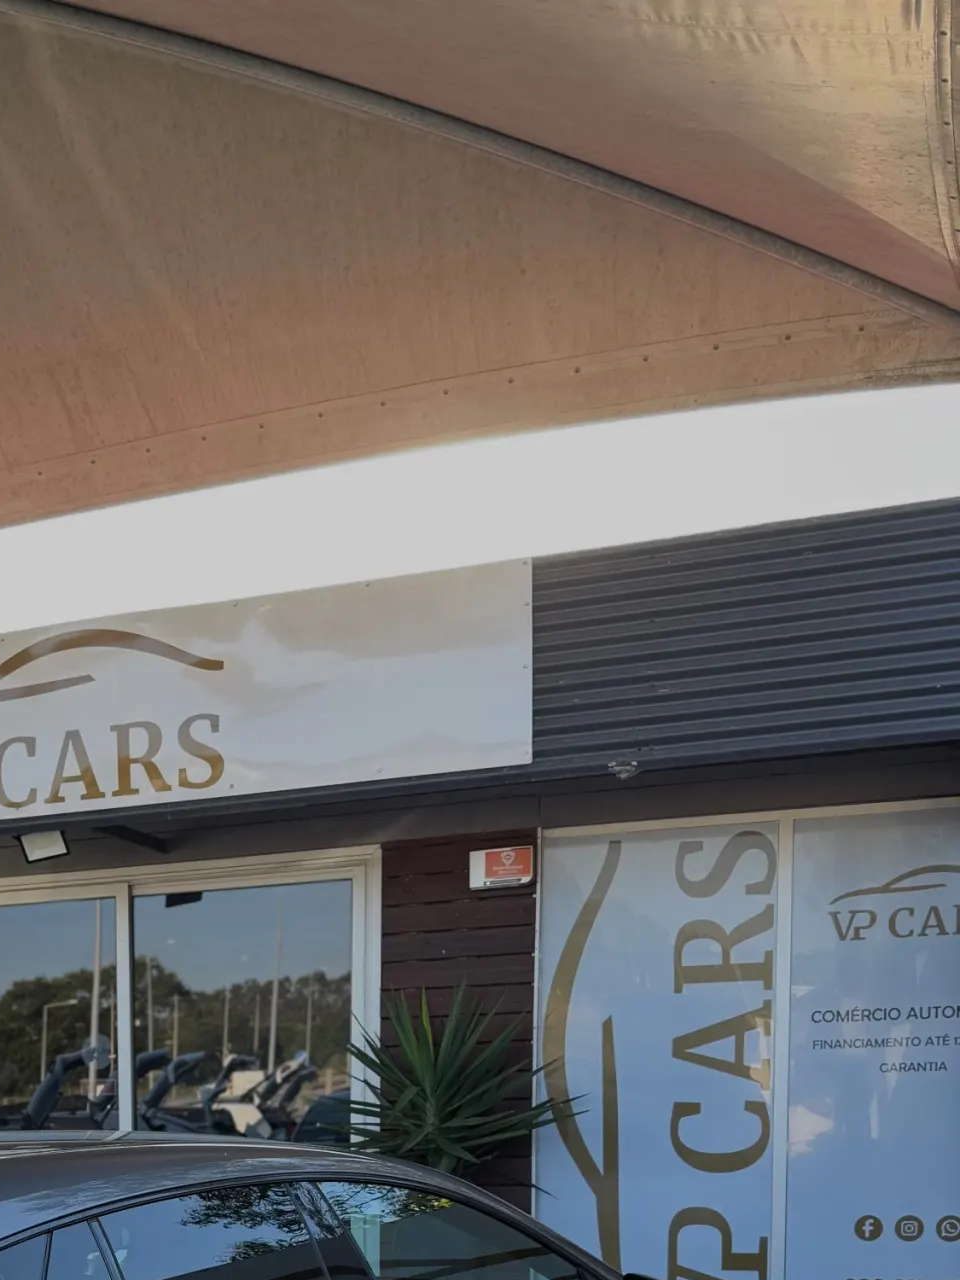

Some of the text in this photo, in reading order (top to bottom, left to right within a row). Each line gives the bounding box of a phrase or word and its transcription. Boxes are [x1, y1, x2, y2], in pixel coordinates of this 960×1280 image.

[827, 909, 877, 942] VP
[670, 830, 777, 1173] CARS
[811, 1005, 960, 1024] COMÉRCIO AUTO
[812, 1036, 922, 1050] FINANCIAMENTO
[924, 1033, 951, 1047] ATÉ
[879, 1061, 948, 1074] GARANTIA
